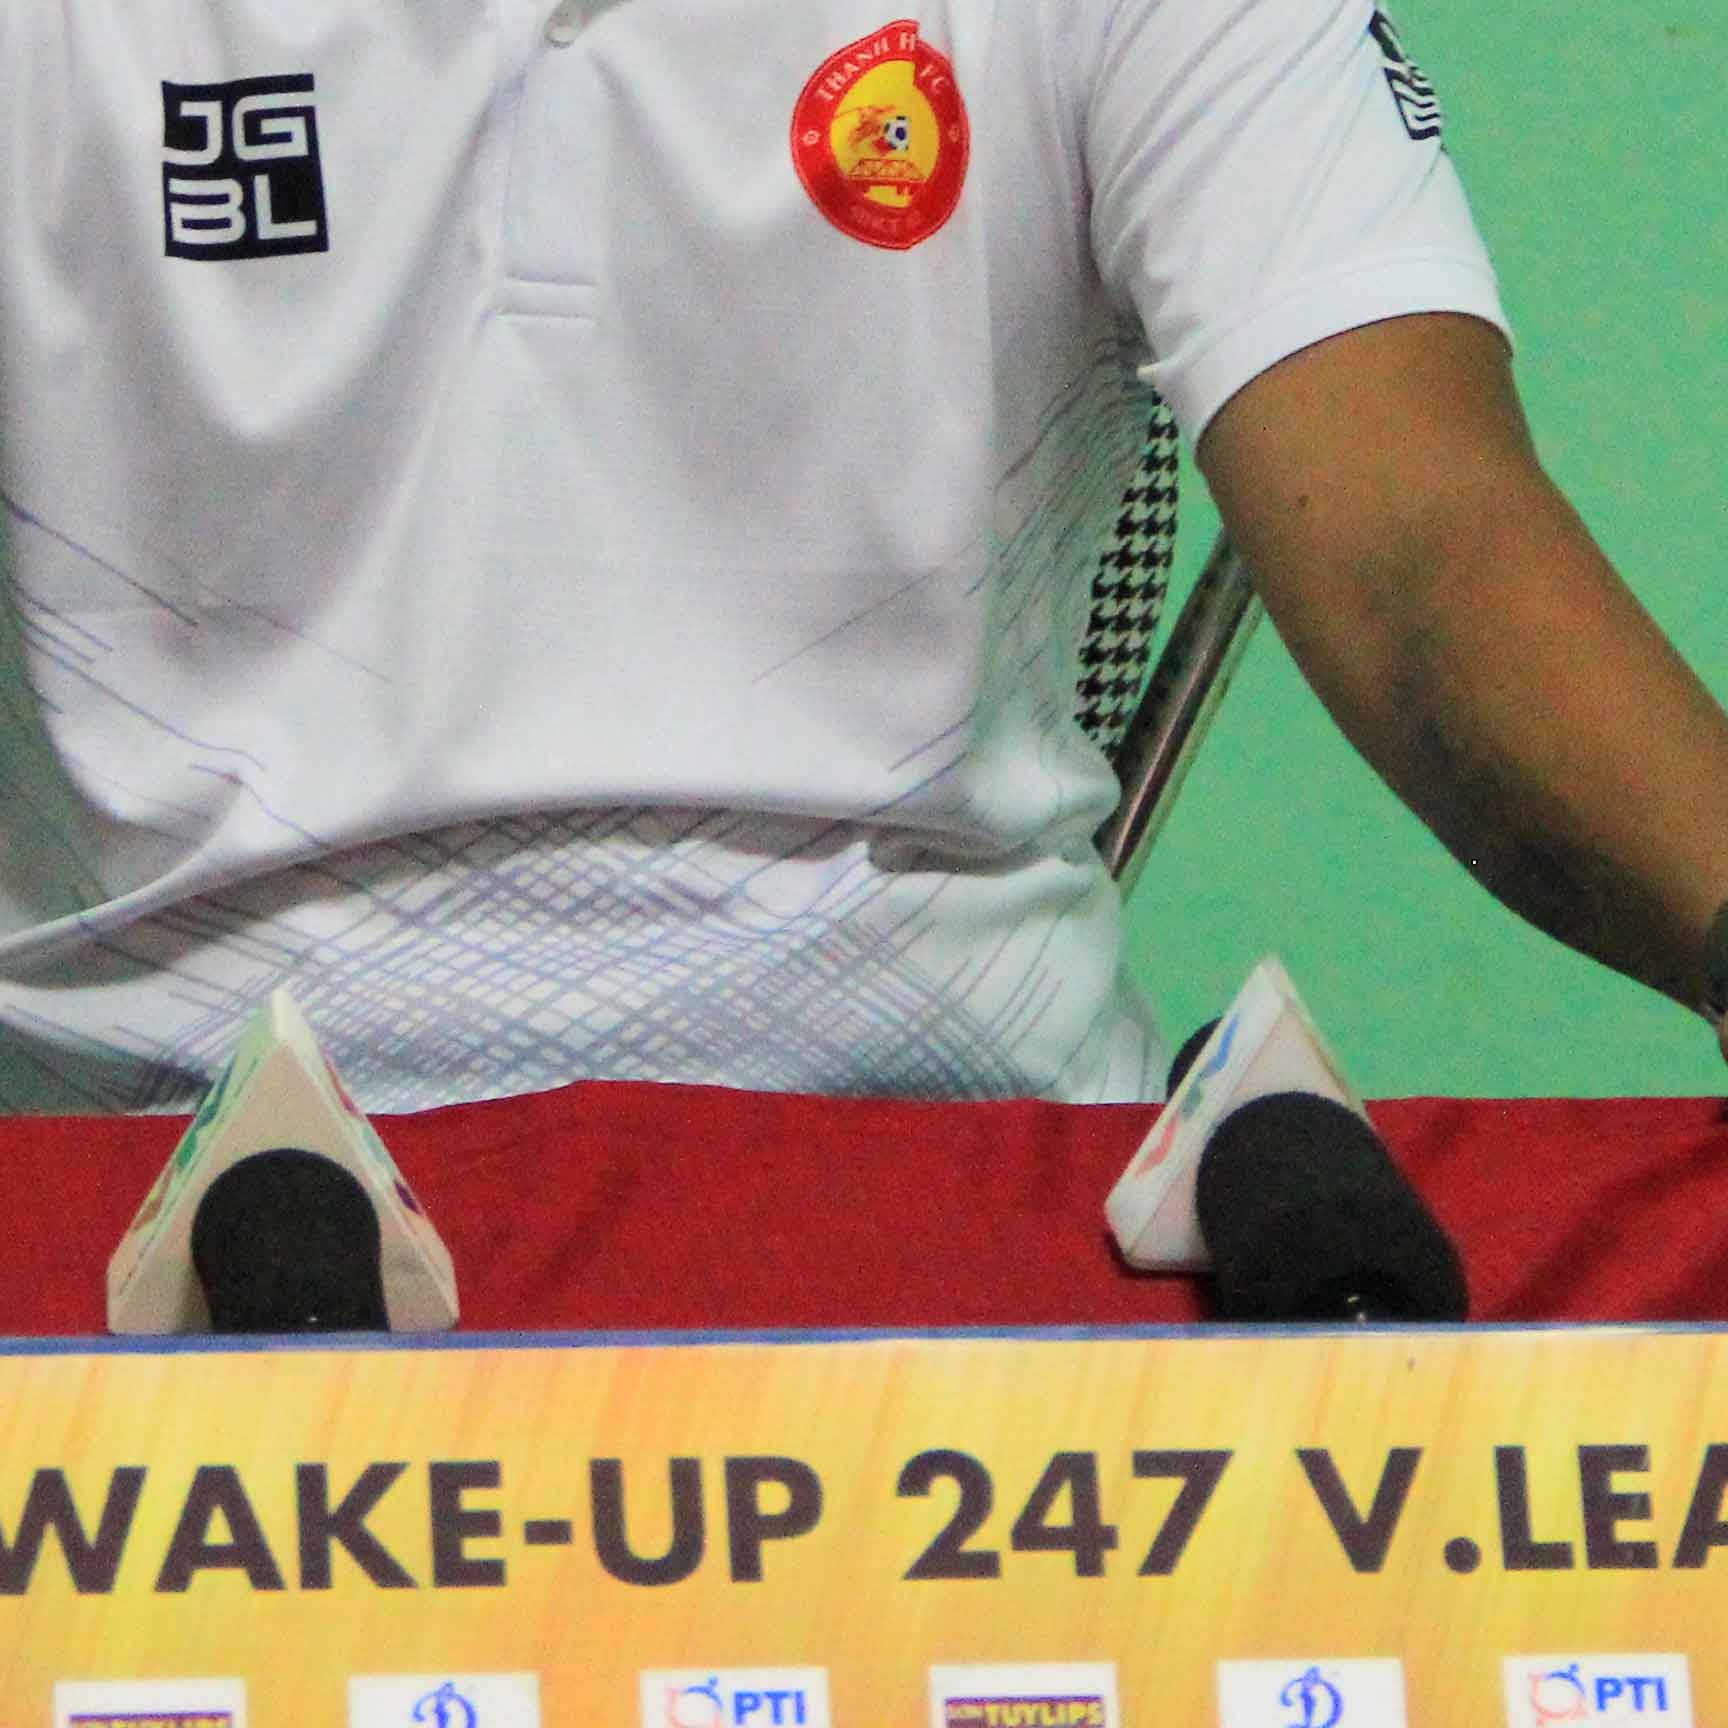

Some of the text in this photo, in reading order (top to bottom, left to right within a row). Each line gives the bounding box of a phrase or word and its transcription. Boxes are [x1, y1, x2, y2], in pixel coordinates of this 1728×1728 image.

[896, 1448, 1233, 1580] 247
[732, 1689, 807, 1726] PTI
[1594, 1676, 1668, 1712] PTI
